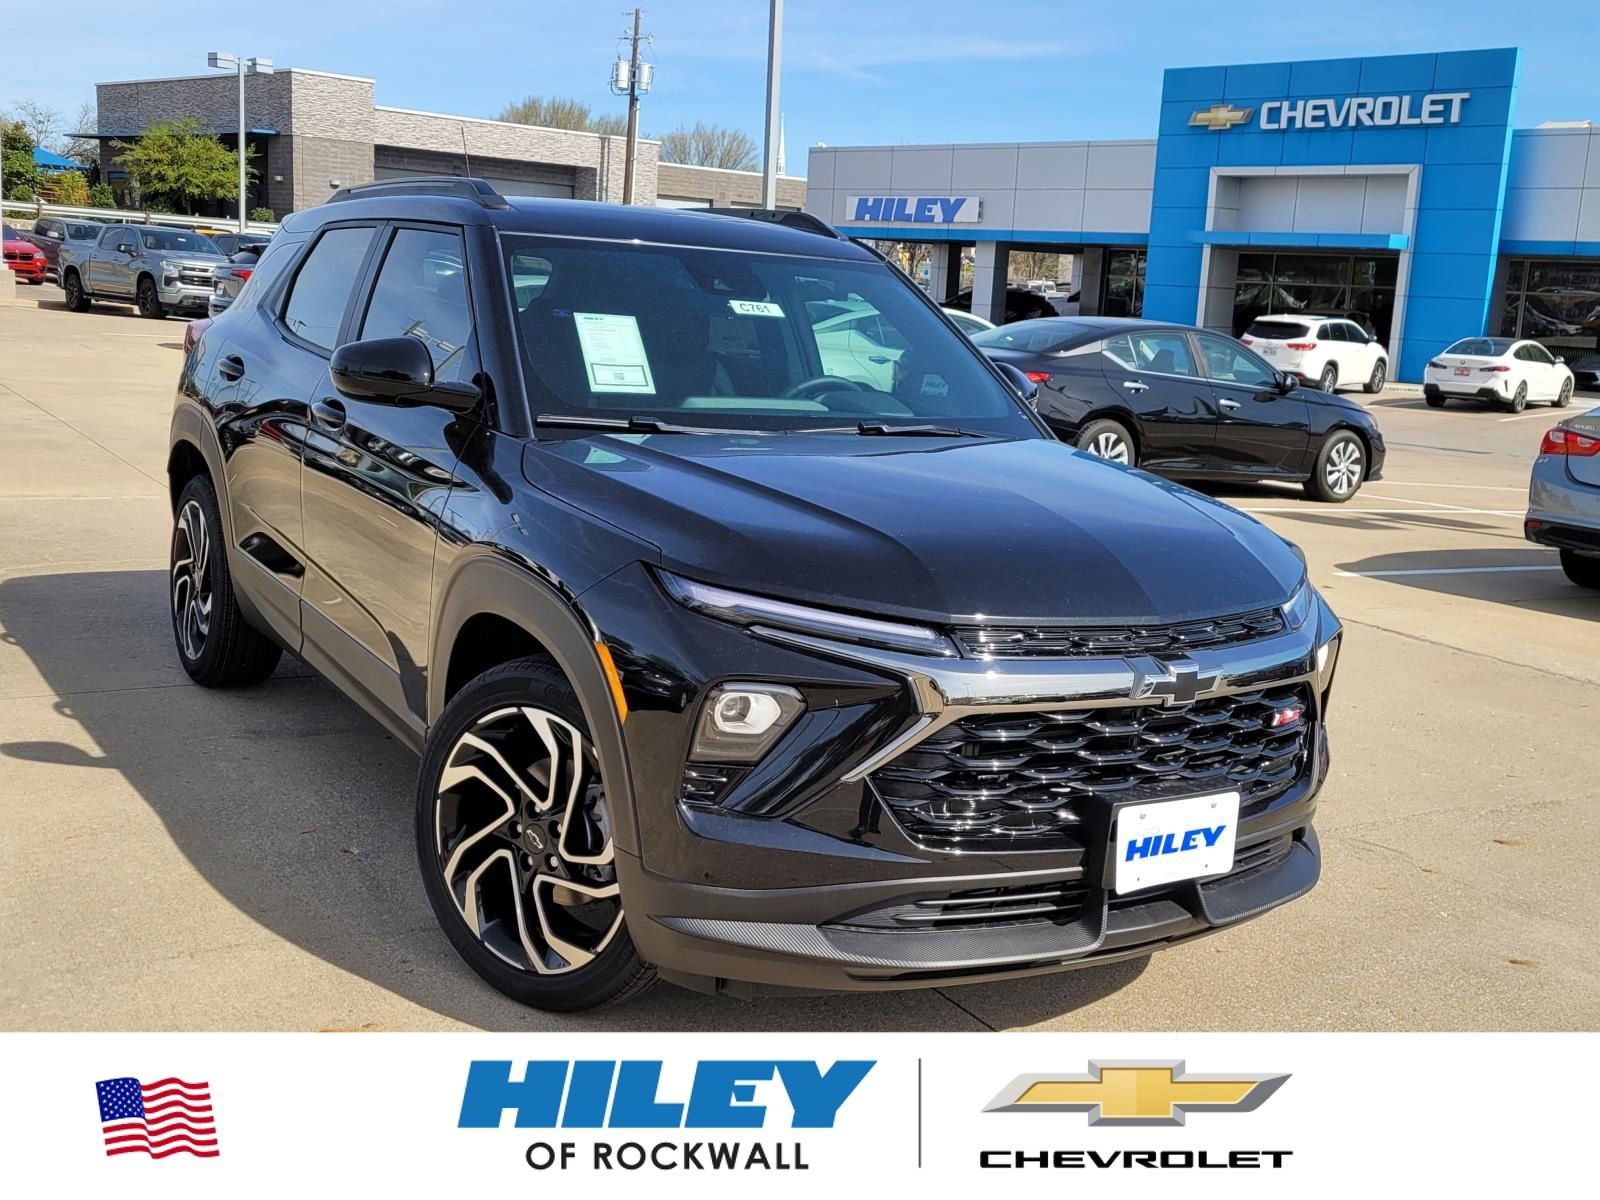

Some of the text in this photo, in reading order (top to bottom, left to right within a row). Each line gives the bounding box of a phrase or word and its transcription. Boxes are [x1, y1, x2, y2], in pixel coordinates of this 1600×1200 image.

[1260, 92, 1470, 130] CHEVROLET
[854, 197, 967, 223] HILEY
[739, 303, 771, 313] C761
[1125, 825, 1227, 862] HILEY
